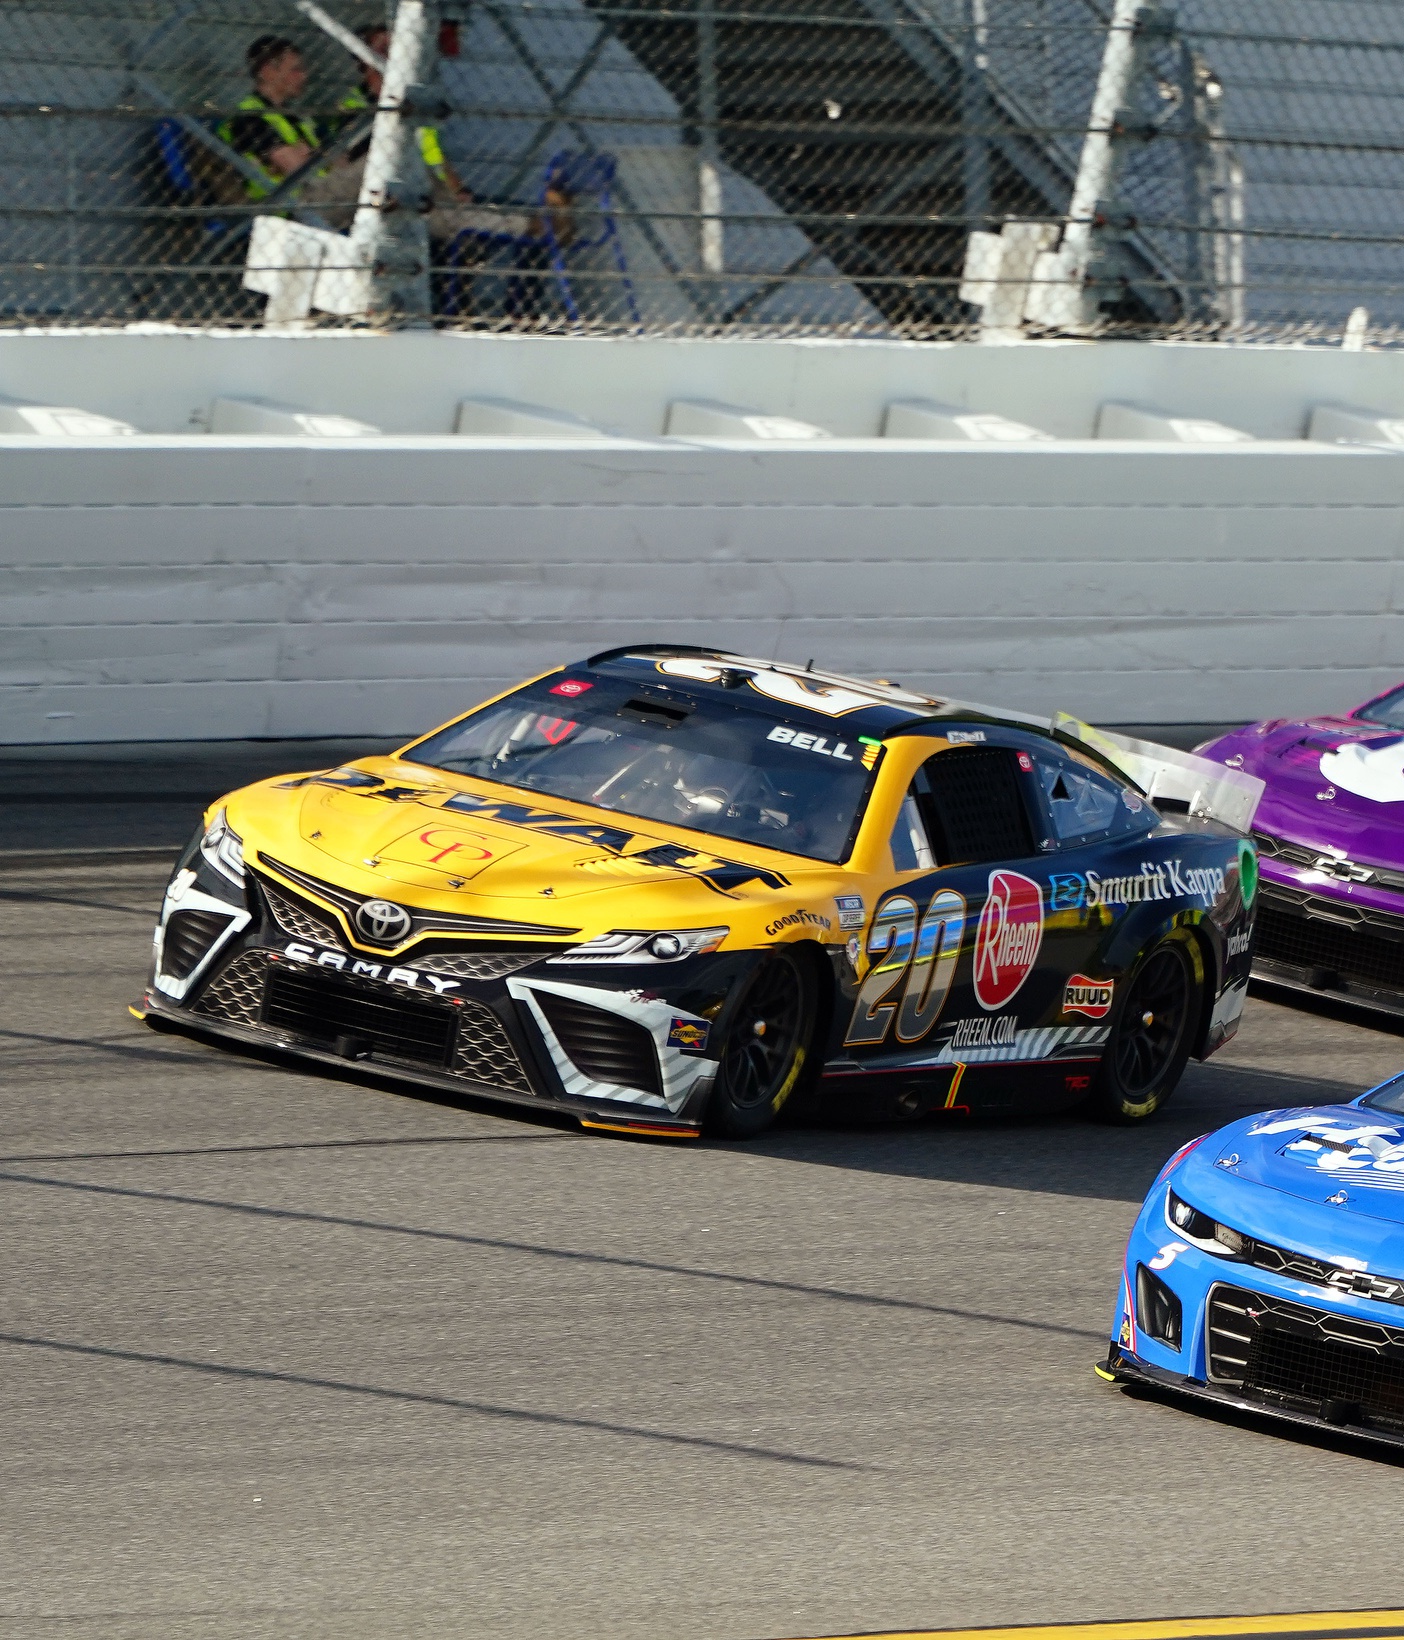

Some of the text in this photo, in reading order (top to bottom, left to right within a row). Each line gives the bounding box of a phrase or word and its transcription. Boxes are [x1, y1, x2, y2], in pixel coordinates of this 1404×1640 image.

[766, 725, 854, 761] BELL
[1085, 859, 1226, 907] Smurfit Kappa
[765, 909, 831, 936] GOODYEAR
[977, 895, 1038, 985] Rheem
[284, 942, 461, 994] CAMRY
[843, 888, 967, 1047] 20
[1065, 987, 1111, 1005] RUUD
[952, 1015, 1018, 1048] RHEEM.COM
[1147, 1241, 1190, 1271] 5
